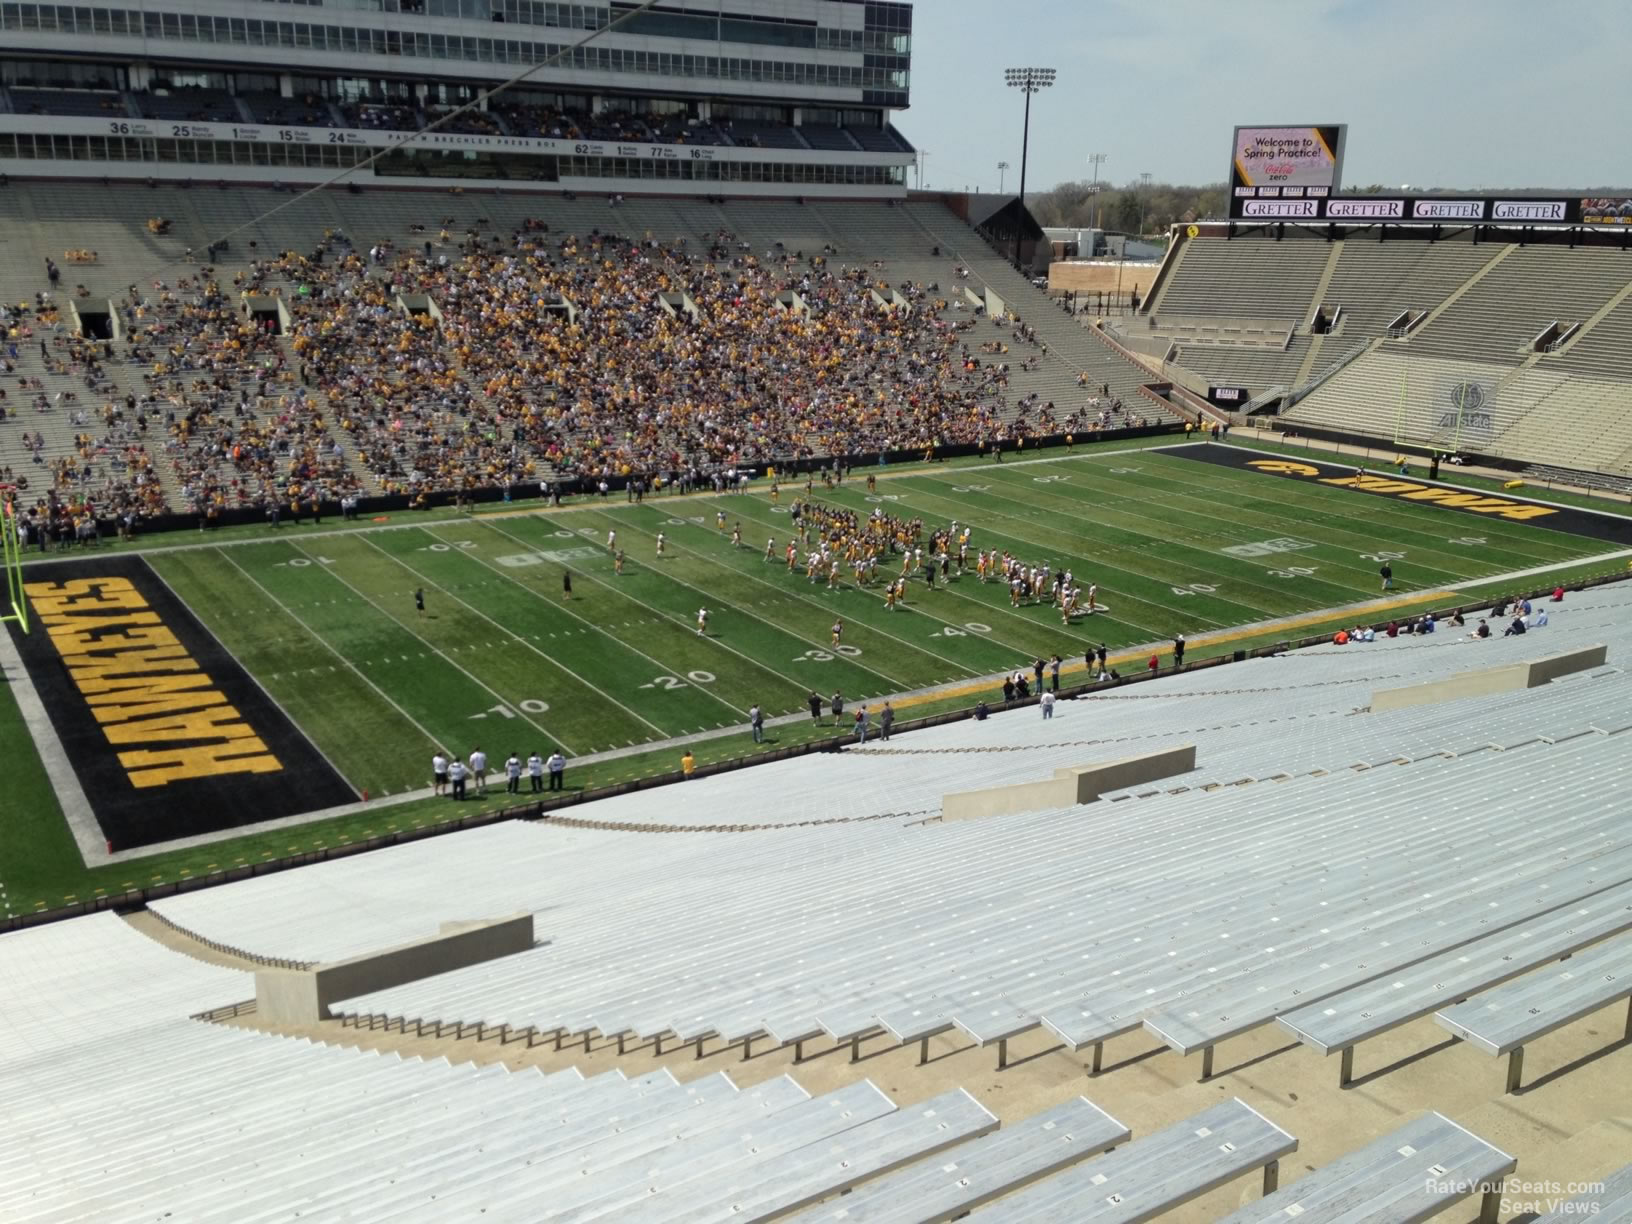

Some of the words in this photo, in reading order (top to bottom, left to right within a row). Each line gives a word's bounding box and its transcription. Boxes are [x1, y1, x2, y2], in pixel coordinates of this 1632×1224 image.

[110, 122, 129, 134] 36
[172, 125, 190, 136] 25
[232, 128, 238, 138] 1
[279, 130, 293, 141] 15
[329, 132, 345, 143] 24
[1255, 137, 1299, 147] Welcome
[1302, 138, 1313, 147] to
[575, 144, 588, 154] 62
[617, 146, 622, 155] 1
[651, 147, 662, 157] 77
[690, 149, 700, 158] 16
[1244, 148, 1275, 159] Spring
[1278, 147, 1321, 158] Practice!
[1245, 201, 1313, 215] GRETTER
[1329, 201, 1399, 216] GRETTER
[1416, 202, 1480, 217] GRETTER
[1495, 203, 1562, 218] GRETTER
[1438, 413, 1490, 429] Alstate
[1317, 475, 1561, 519] IOWA
[1360, 551, 1402, 562] 20
[1267, 566, 1314, 579] 30
[1171, 583, 1217, 596] 40
[939, 622, 992, 638] 40
[804, 645, 863, 662] 30
[23, 576, 284, 789] HAWKEYES
[653, 670, 717, 691] 20
[486, 699, 550, 720] 10
